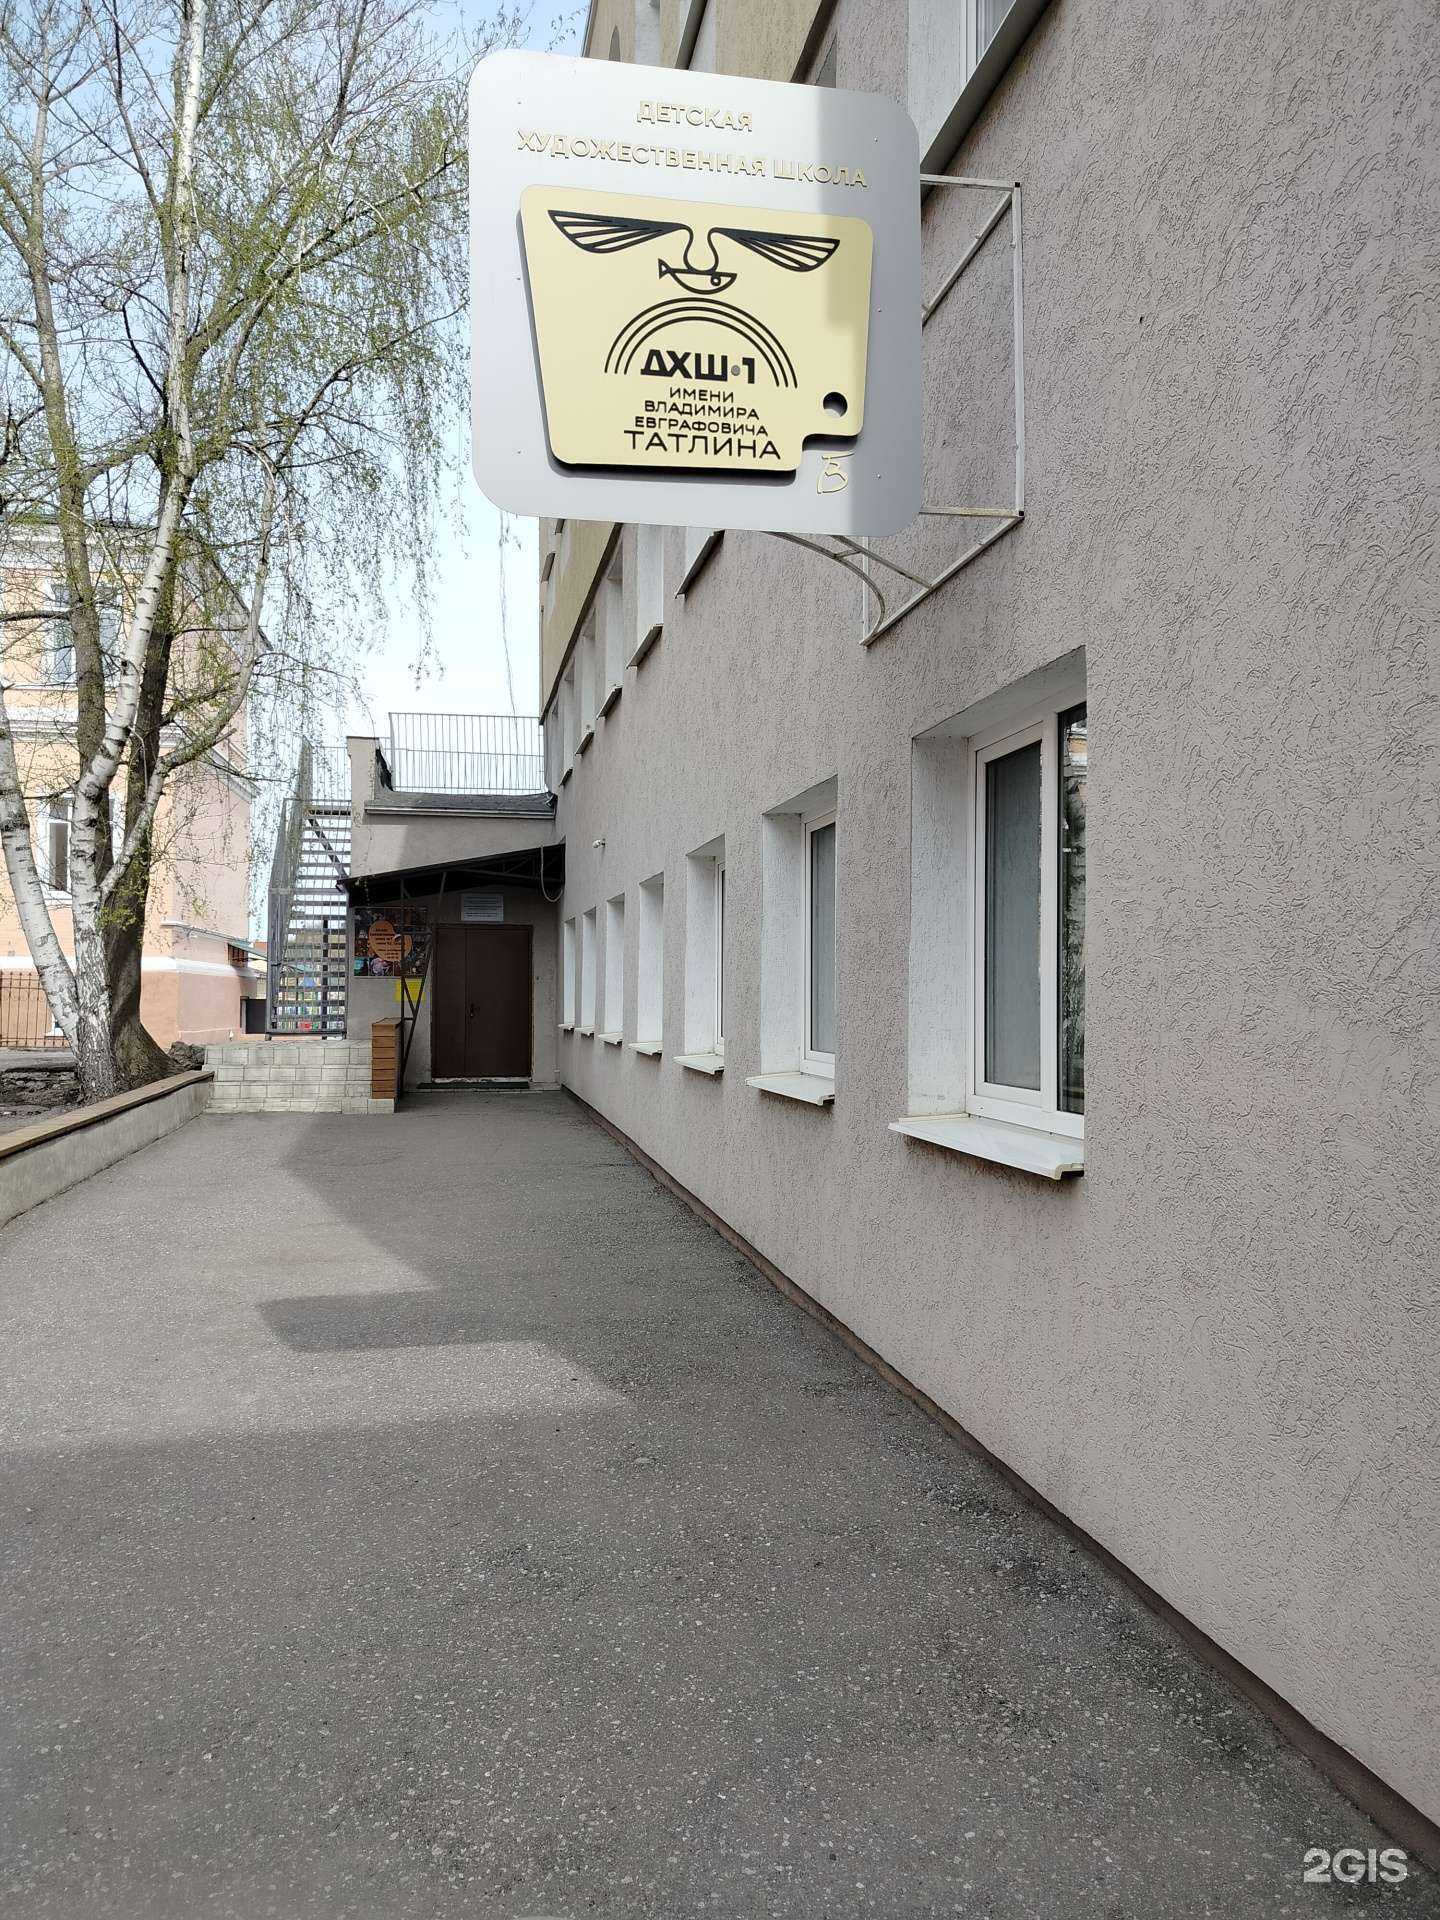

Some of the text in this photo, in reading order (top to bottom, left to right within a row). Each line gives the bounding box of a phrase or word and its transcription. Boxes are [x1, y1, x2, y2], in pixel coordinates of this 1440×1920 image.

[636, 100, 753, 133] ДЕТСКАЯ
[517, 128, 868, 189] ХУДОЖЕСТВЕННАЯ ШКОЛА
[669, 386, 735, 404] ИМЕНИ
[644, 400, 760, 421] ВЛАДИМИРА
[634, 416, 769, 437] ЕВГРАФОВИЧА
[623, 430, 781, 460] ТАТЛИНА
